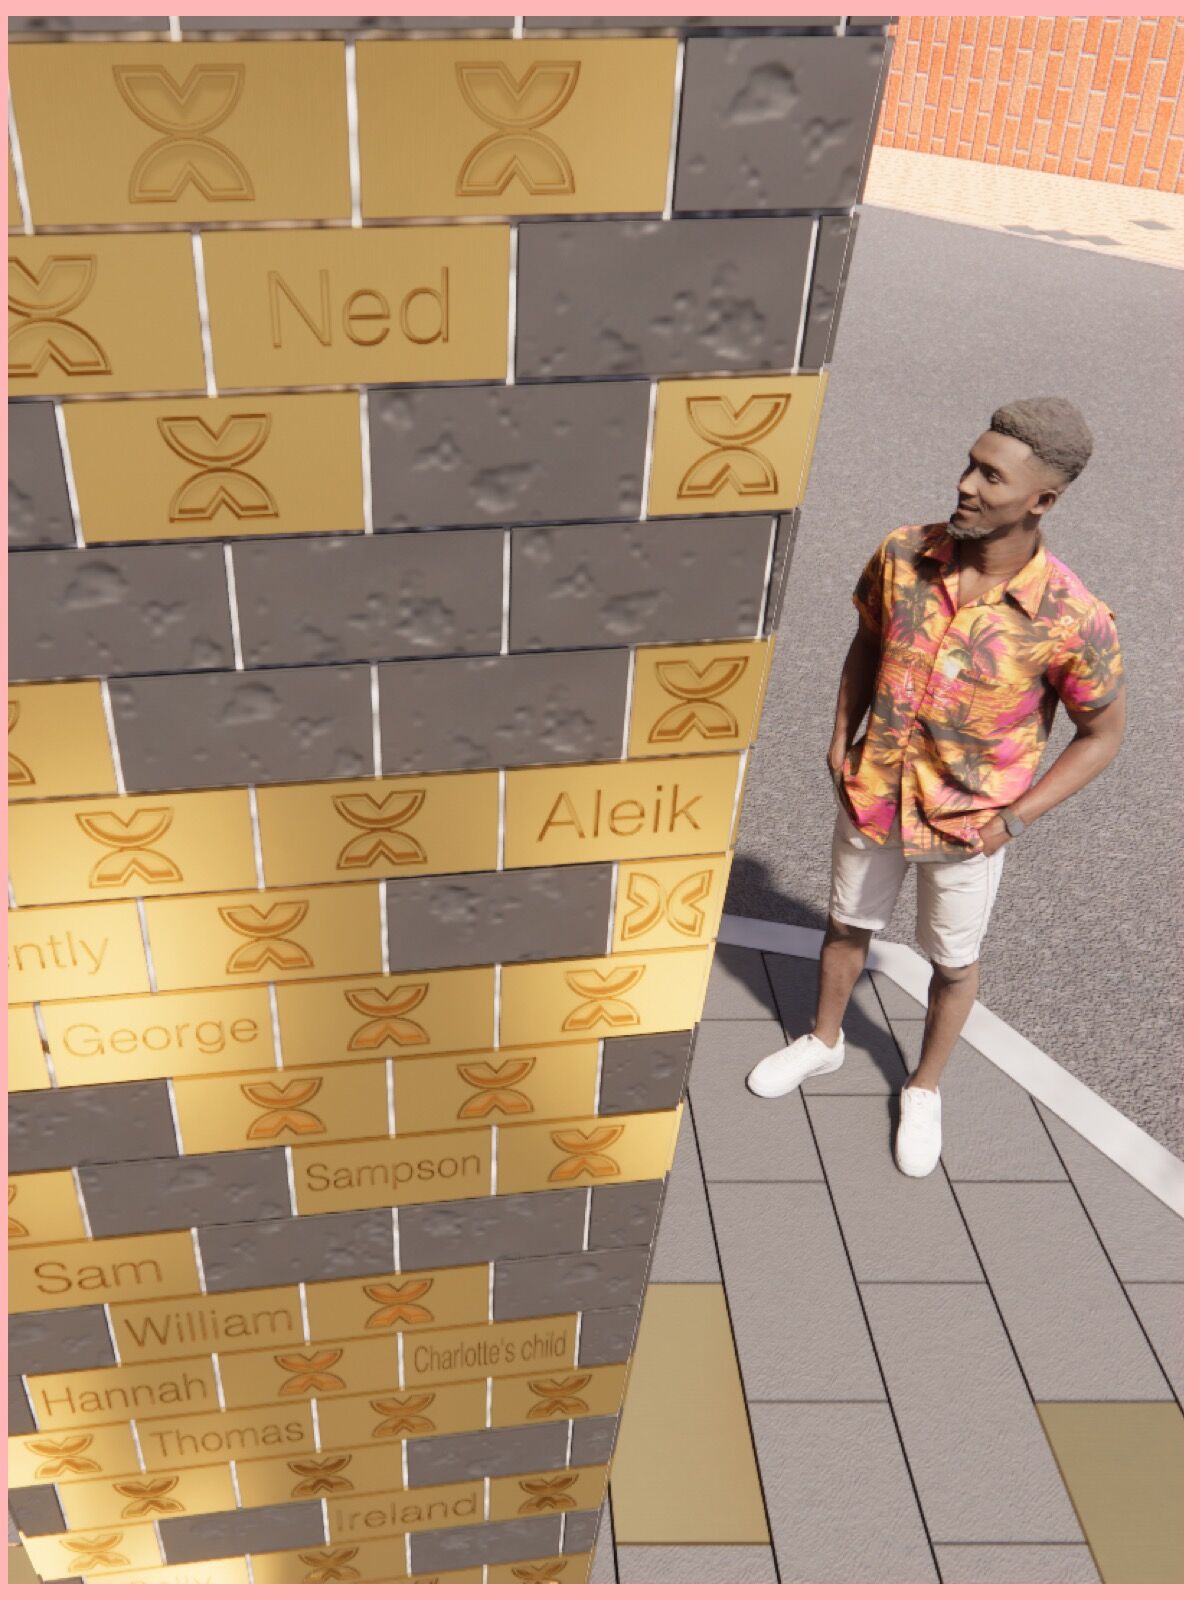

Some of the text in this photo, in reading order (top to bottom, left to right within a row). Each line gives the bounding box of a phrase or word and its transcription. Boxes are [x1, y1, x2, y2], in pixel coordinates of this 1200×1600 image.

[267, 266, 450, 349] Ned
[538, 785, 704, 844] Aleik
[8, 930, 109, 975] ntly
[61, 1009, 260, 1060] George
[305, 1148, 482, 1193] Sampson
[33, 1258, 164, 1295] Sam
[123, 1309, 294, 1348] William
[414, 1331, 567, 1373] Charlotte's child
[40, 1373, 208, 1416] Hannah
[148, 1421, 305, 1458] Thomas
[335, 1492, 478, 1532] Ireland
